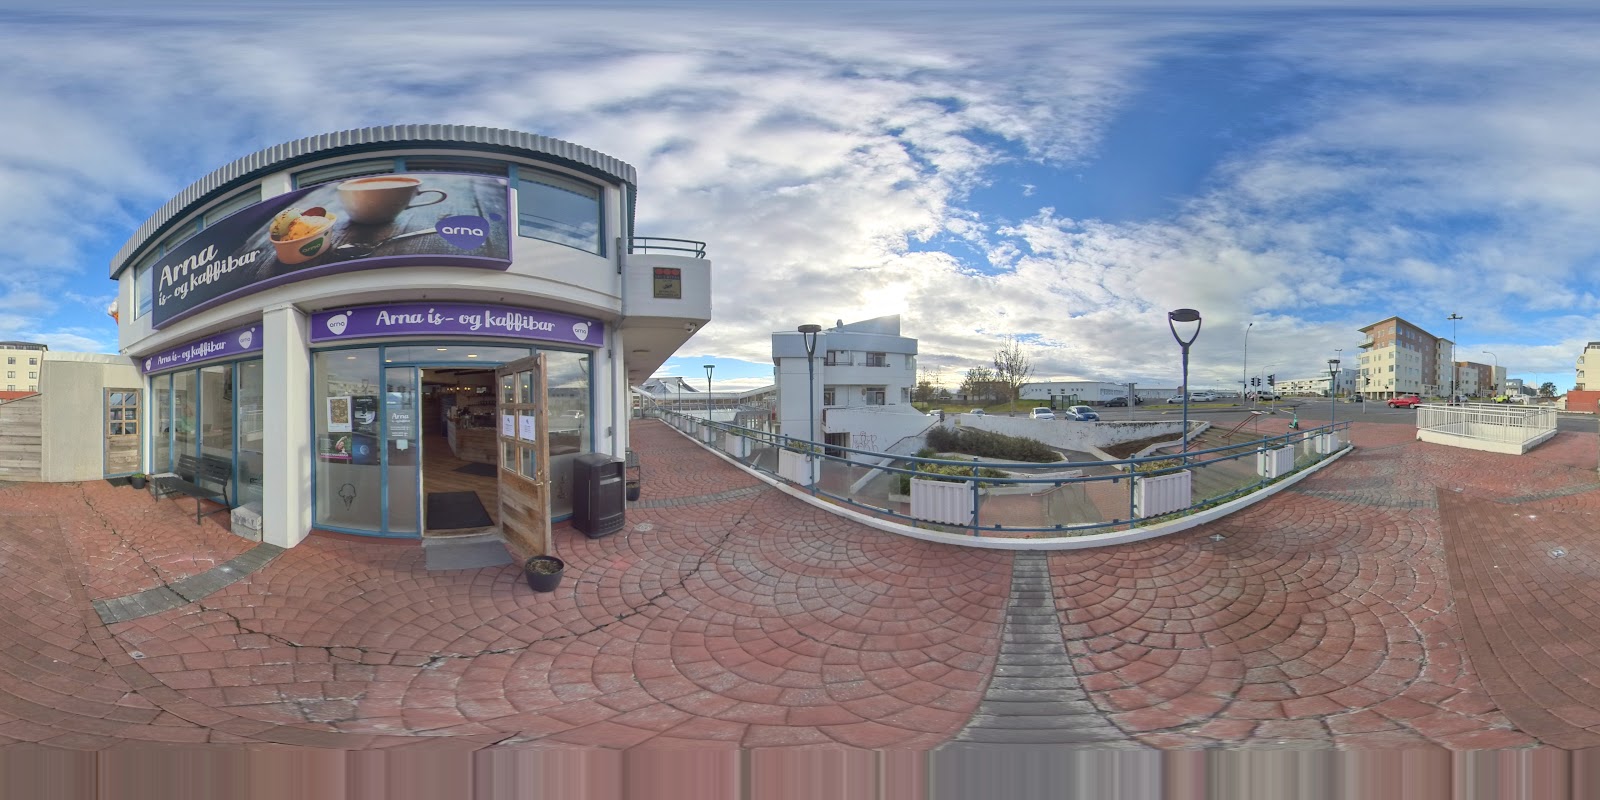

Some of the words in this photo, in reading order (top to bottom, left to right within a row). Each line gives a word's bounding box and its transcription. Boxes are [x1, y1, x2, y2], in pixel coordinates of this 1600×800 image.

[441, 226, 484, 237] arna
[158, 244, 218, 292] Arna
[173, 282, 189, 300] og
[190, 249, 260, 292] kaffibar
[329, 321, 346, 329] arna
[375, 310, 424, 326] Arna
[458, 314, 483, 331] og
[485, 310, 556, 332] kaffibar
[157, 355, 172, 365] Arna
[181, 350, 192, 362] og
[191, 340, 227, 358] kaffibar
[391, 412, 410, 420] Arna
